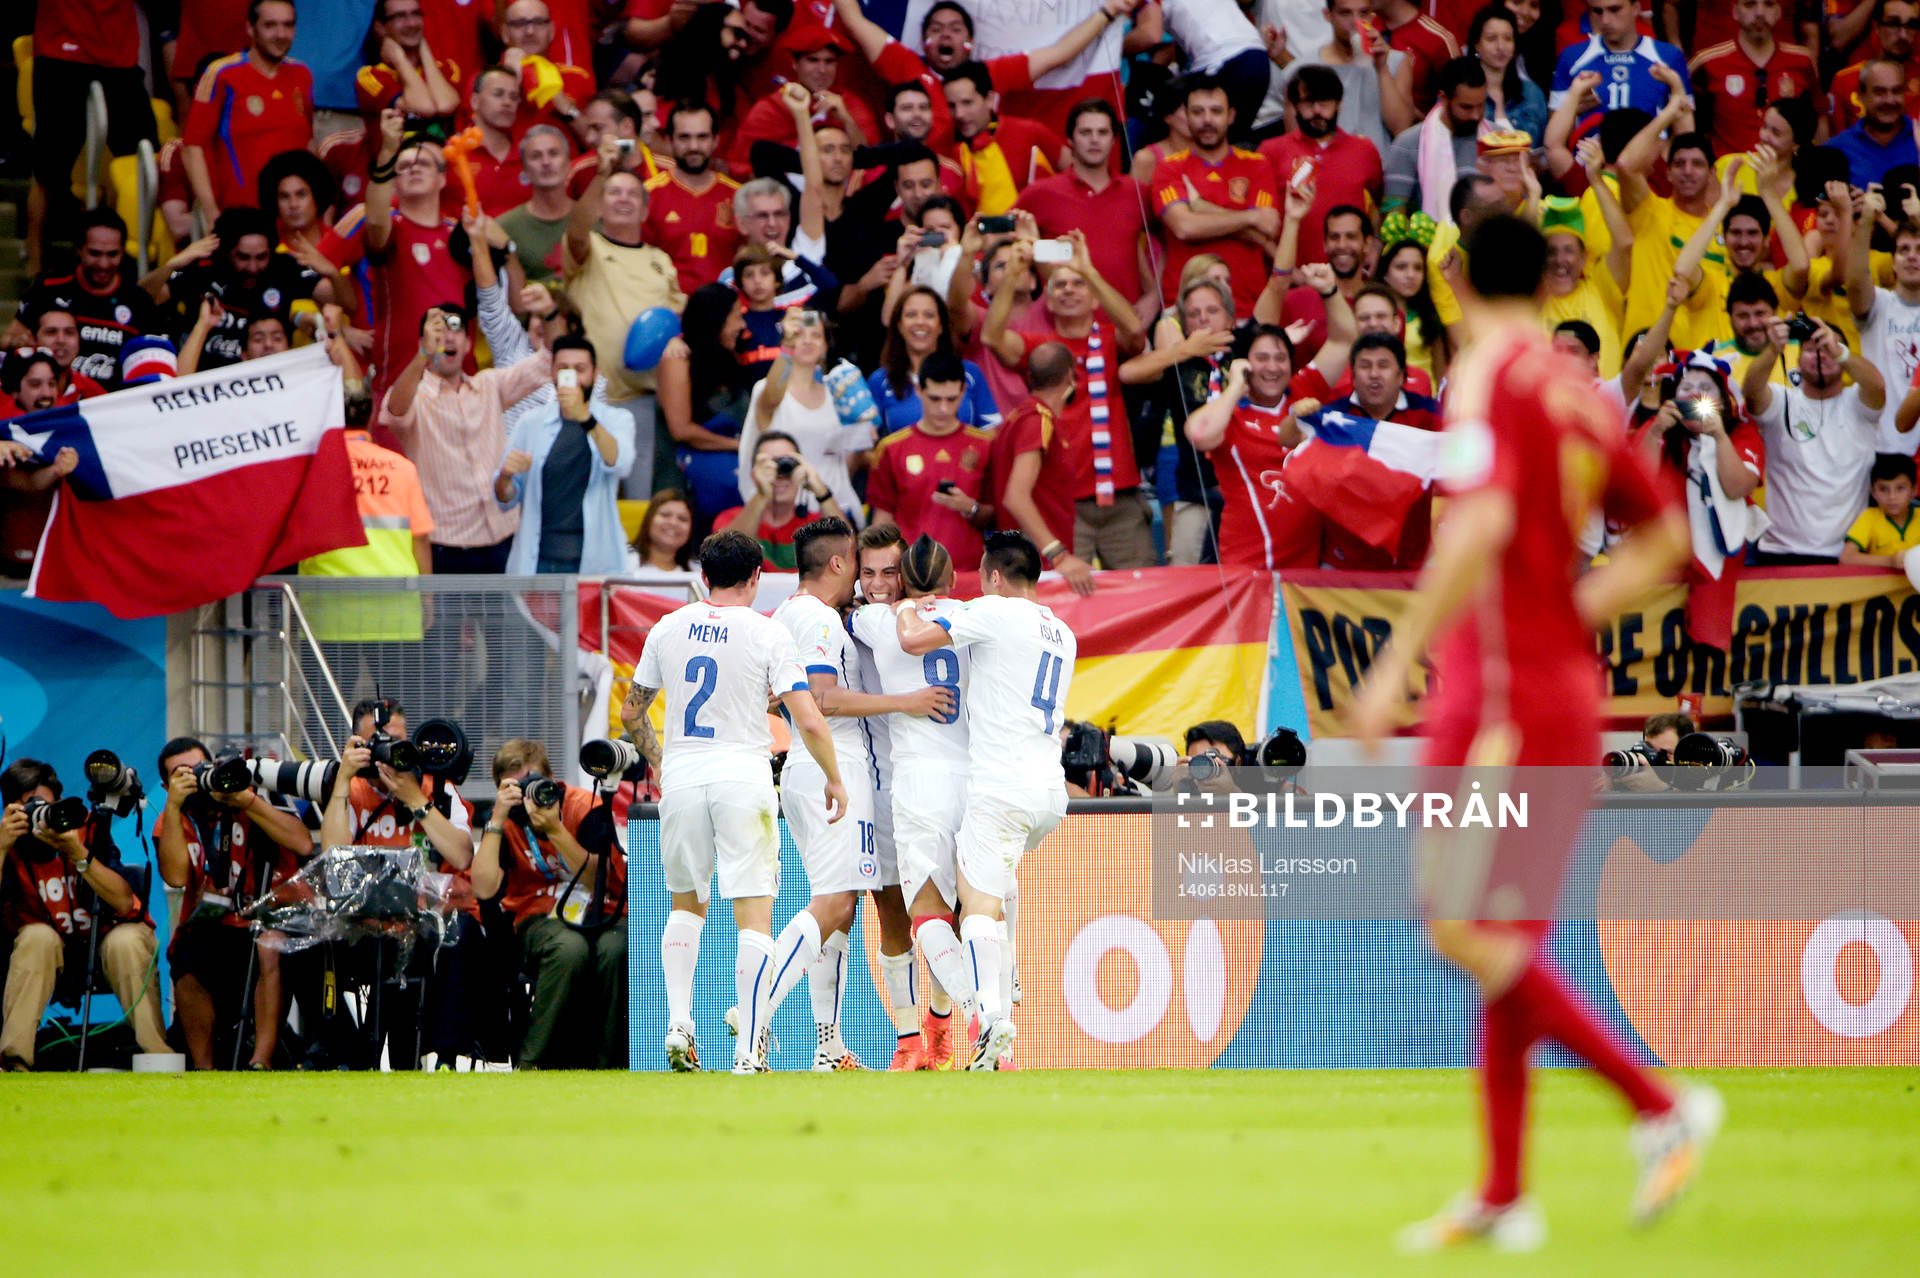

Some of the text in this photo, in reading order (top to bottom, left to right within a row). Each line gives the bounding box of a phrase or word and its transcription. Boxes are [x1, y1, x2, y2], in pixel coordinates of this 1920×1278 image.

[1607, 82, 1630, 110] 11
[80, 325, 123, 346] entel
[174, 420, 301, 469] PRESENTE
[687, 623, 728, 644] MENA
[1039, 622, 1063, 647] ISLA
[683, 655, 718, 739] 2
[922, 648, 961, 724] 8
[1031, 651, 1062, 735] 4
[857, 820, 875, 856] 18
